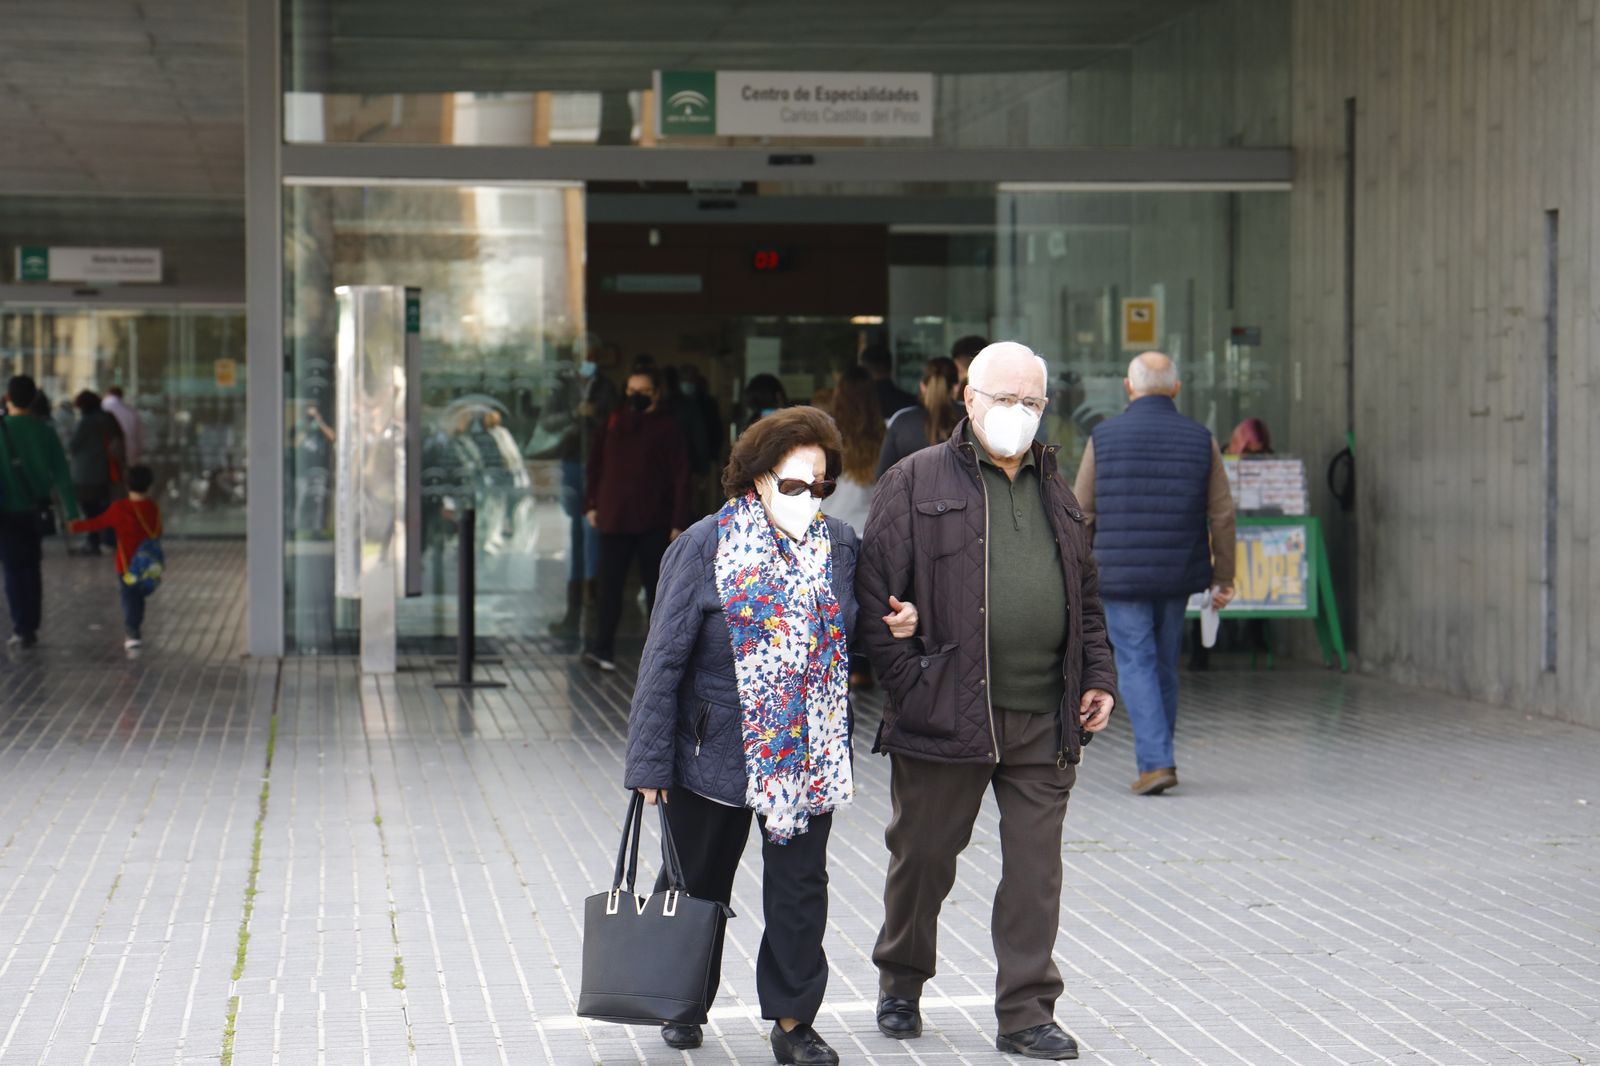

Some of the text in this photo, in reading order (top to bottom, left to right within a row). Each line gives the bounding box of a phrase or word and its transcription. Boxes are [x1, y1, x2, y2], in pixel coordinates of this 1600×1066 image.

[742, 86, 919, 103] Centro de Especialidades
[781, 107, 920, 123] Carlos Castilla del Pino
